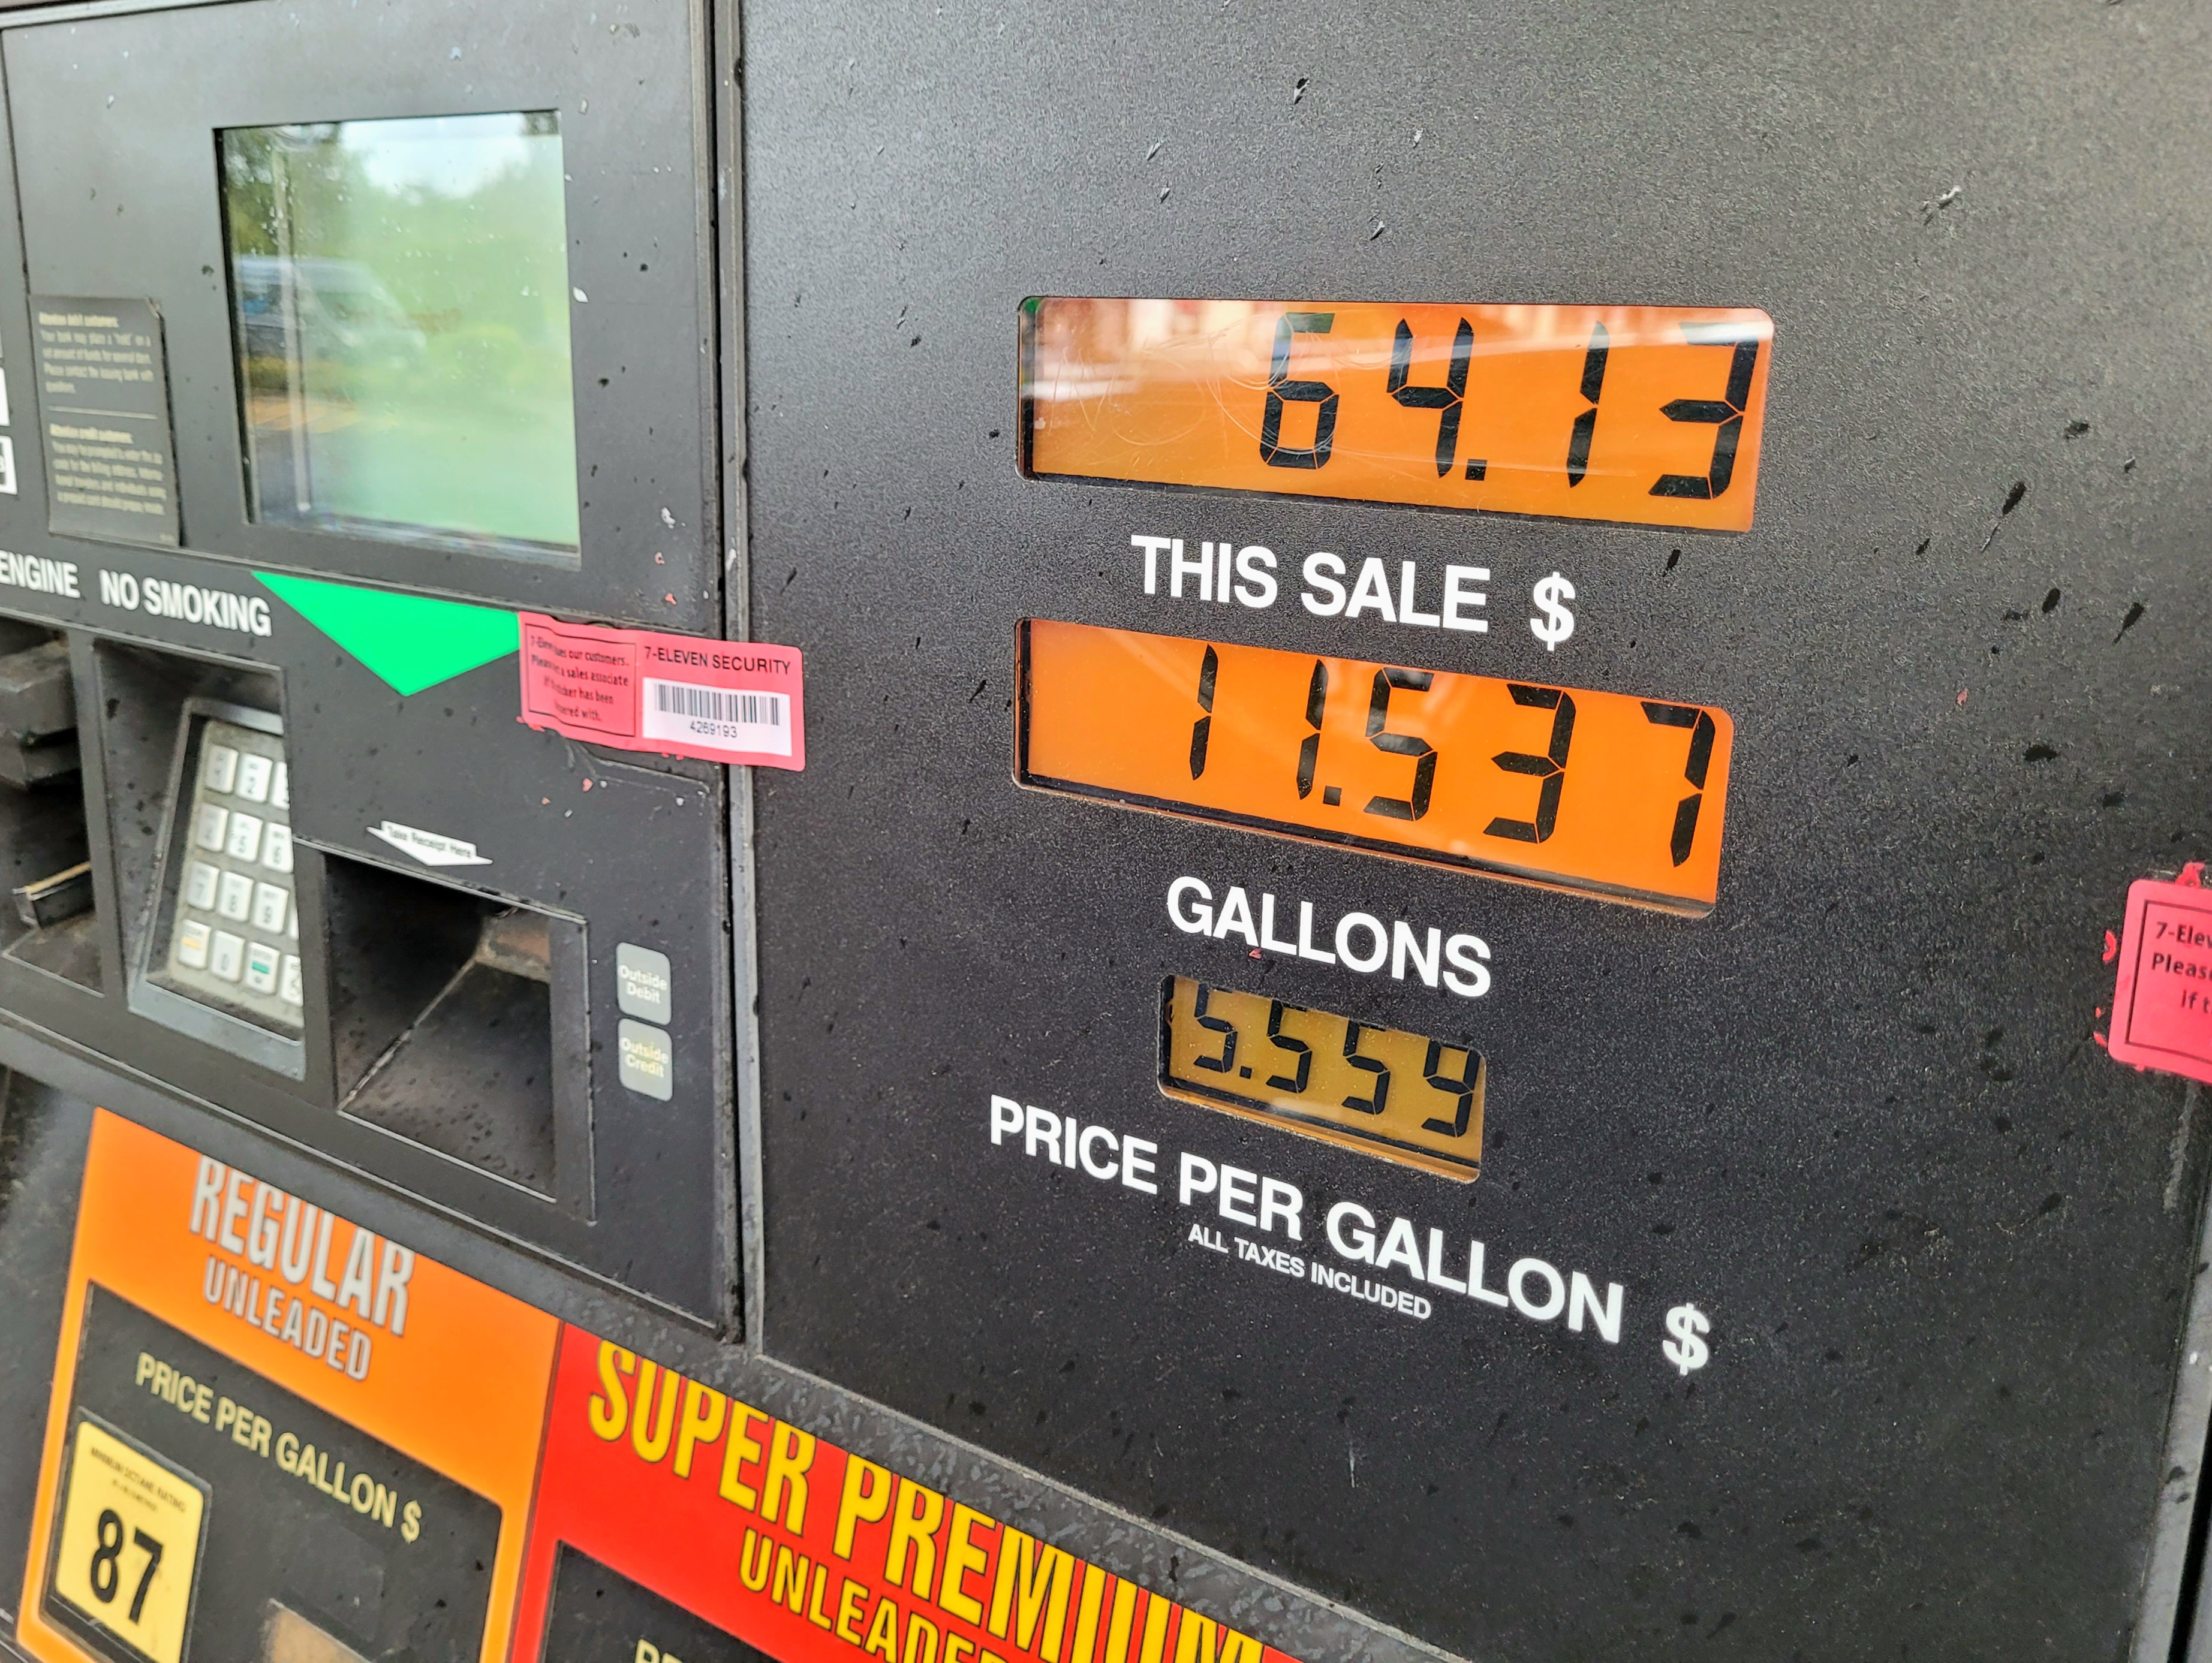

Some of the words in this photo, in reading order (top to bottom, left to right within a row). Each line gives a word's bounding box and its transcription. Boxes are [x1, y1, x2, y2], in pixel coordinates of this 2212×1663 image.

[1260, 311, 1757, 500] 64.13
[0, 549, 81, 598] ENGINE
[99, 568, 140, 610] NO
[142, 576, 272, 637] SMOKING
[1131, 535, 1278, 608] THIS
[1301, 552, 1490, 632] SALE
[1530, 571, 1576, 651] $
[567, 666, 588, 680] sales
[591, 672, 628, 686] associate
[568, 649, 583, 659] our
[579, 686, 594, 701] has
[595, 690, 613, 704] been
[645, 646, 708, 667] 7-ELEVEN
[712, 655, 790, 675] SECURITY
[690, 721, 738, 739] 4269193
[1190, 644, 1716, 867] 11.537
[618, 965, 667, 990] Outside
[1166, 876, 1492, 998] GALLONS
[626, 981, 661, 1004] Debit
[619, 1037, 669, 1065] Outside
[625, 1053, 665, 1078] Credit
[1193, 983, 1481, 1138] 5.559
[189, 1154, 416, 1338] REGULAR
[989, 1094, 1158, 1195] PRICE
[1179, 1152, 1303, 1242] PER
[1326, 1201, 1624, 1343] GALLON
[1662, 1303, 1710, 1376] $
[1188, 1223, 1229, 1254] ALL
[1234, 1237, 1305, 1278] TAXES
[1311, 1261, 1432, 1319] INCLUDED
[203, 1255, 372, 1381] UNLEADED
[135, 1351, 214, 1424] PRICE
[215, 1396, 273, 1459] PER
[275, 1432, 398, 1528] GALLON
[401, 1499, 422, 1544] $
[588, 1339, 817, 1538] SUPER
[91, 1509, 164, 1625] 87
